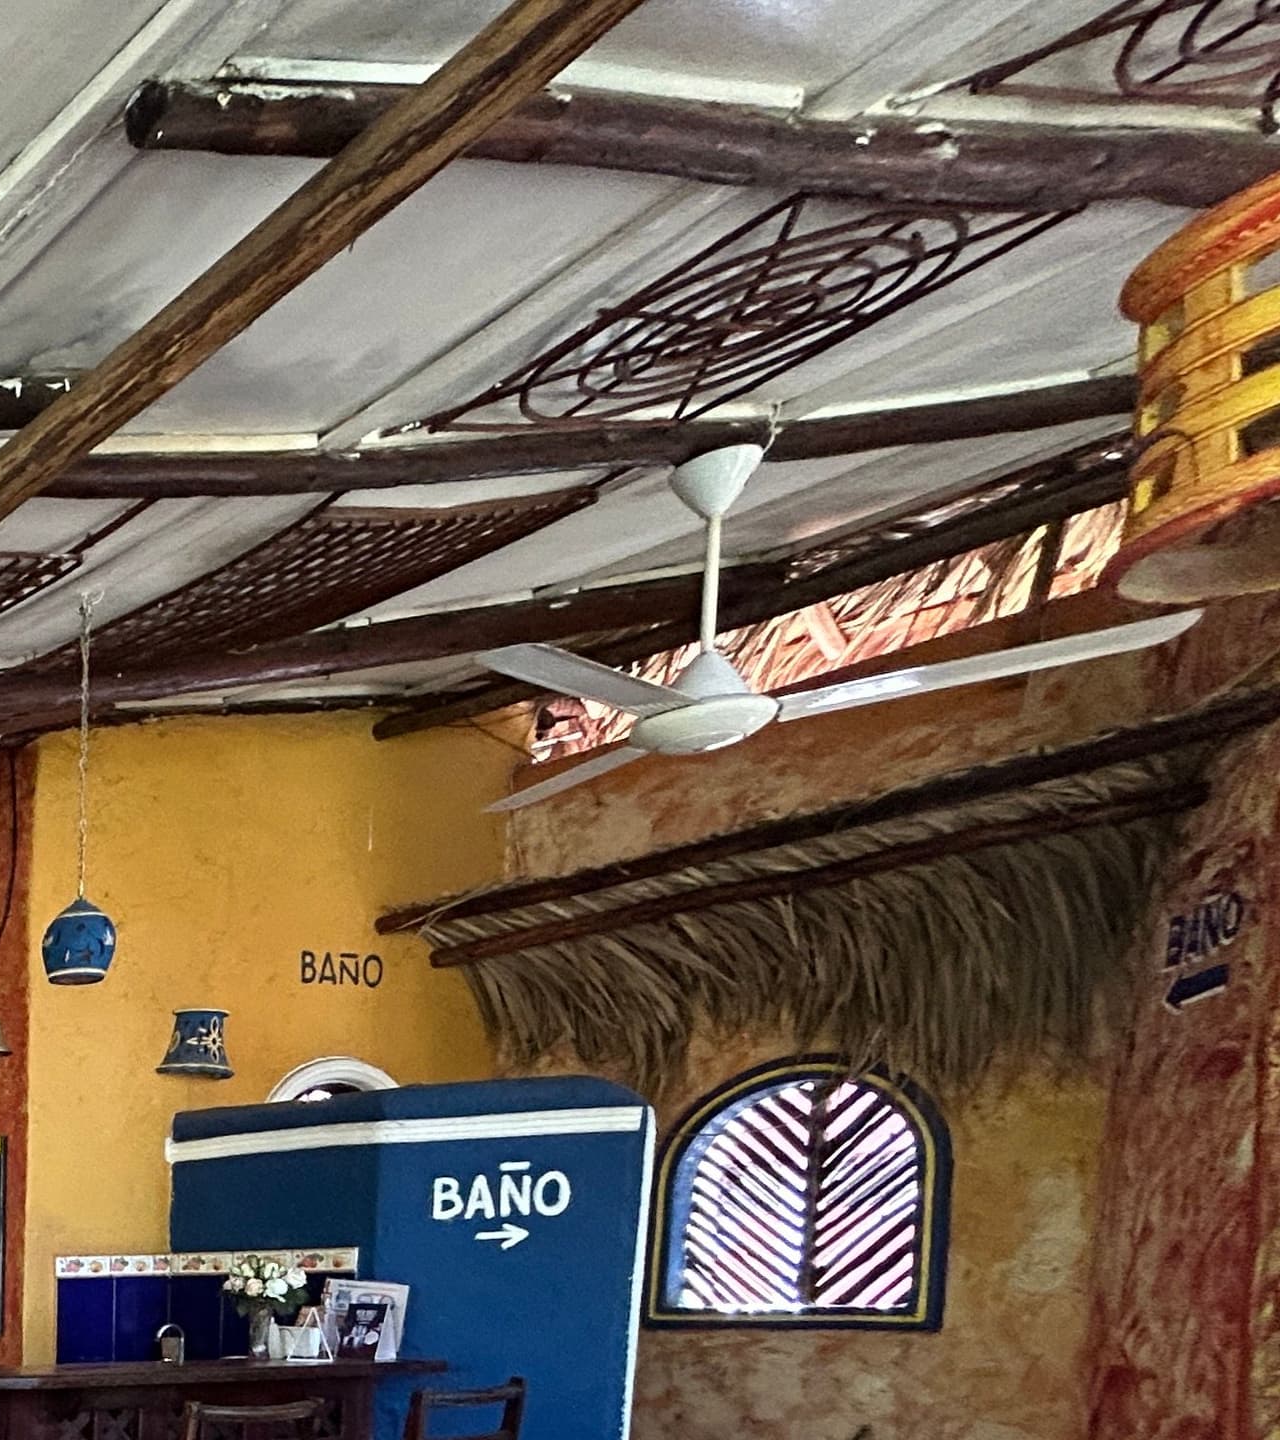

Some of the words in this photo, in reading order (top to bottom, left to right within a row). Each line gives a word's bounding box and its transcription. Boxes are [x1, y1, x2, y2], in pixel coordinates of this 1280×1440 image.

[1166, 889, 1244, 967] BAÑO
[301, 950, 383, 988] BAÑO
[432, 1161, 571, 1220] BAÑO
